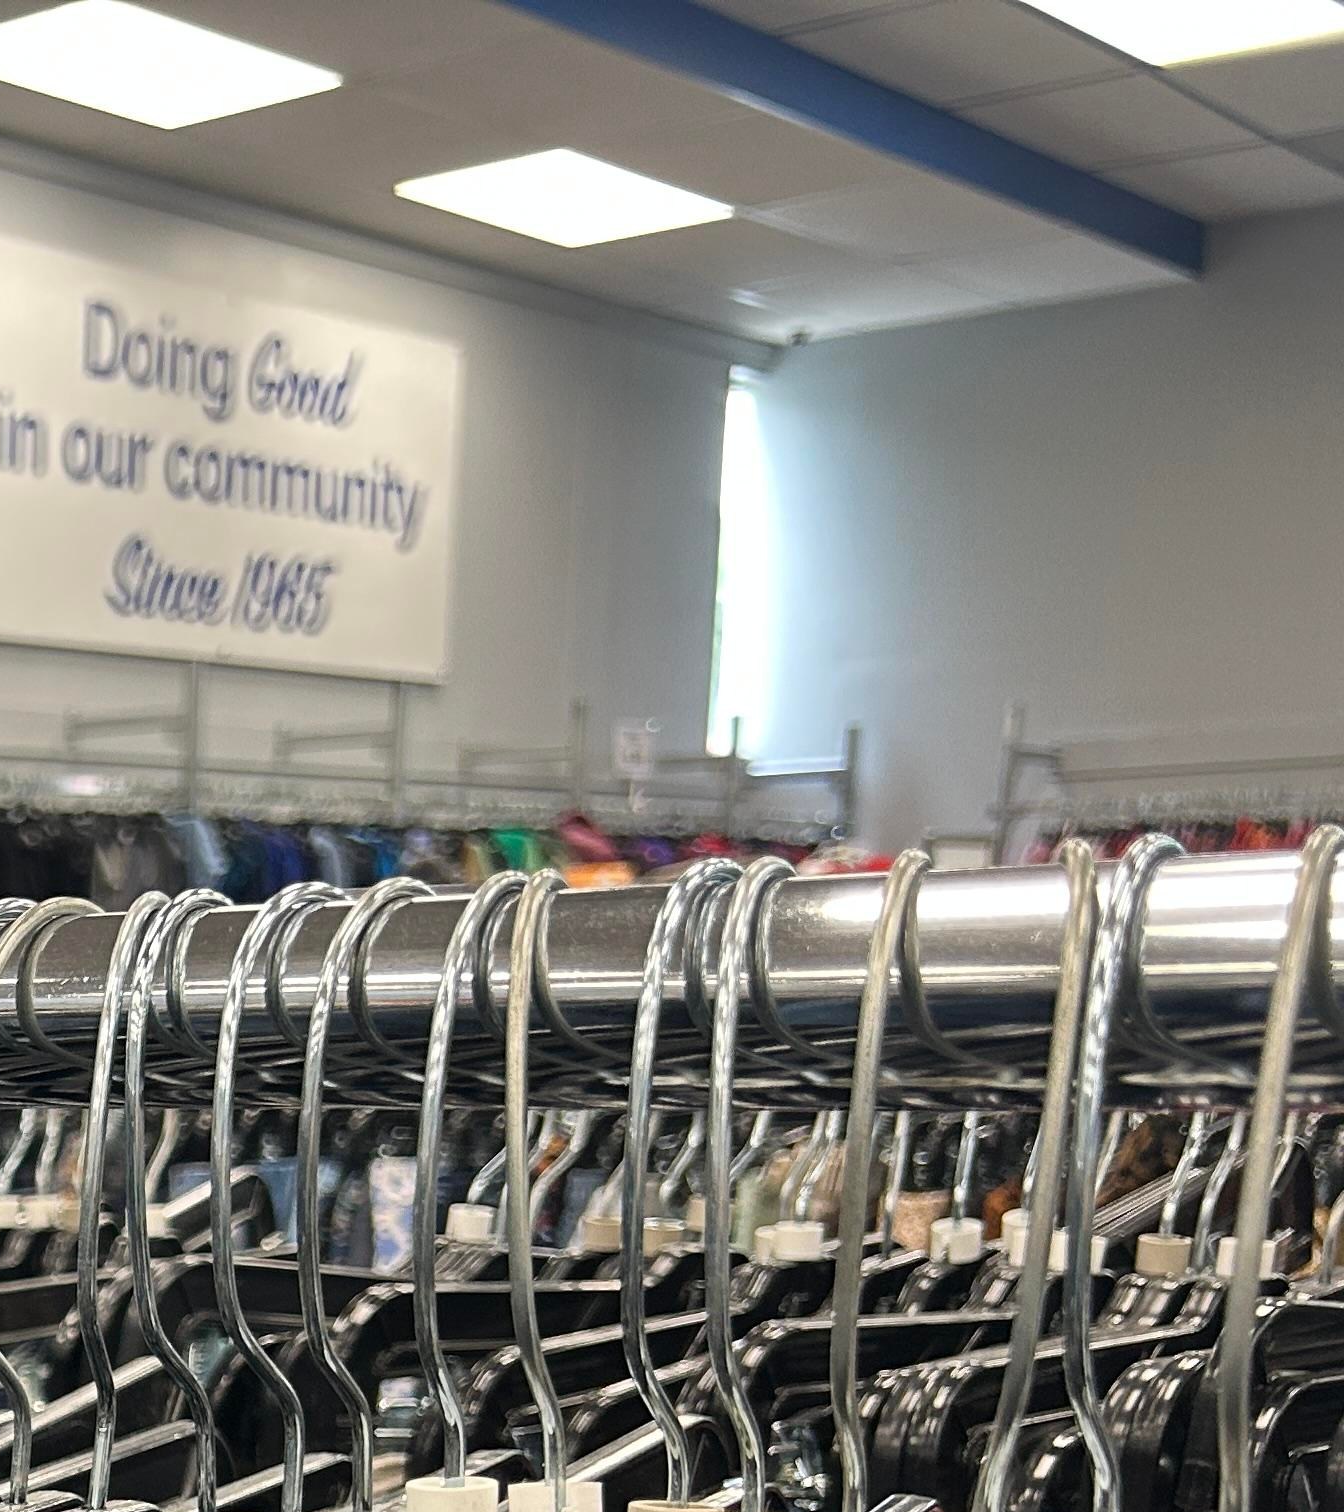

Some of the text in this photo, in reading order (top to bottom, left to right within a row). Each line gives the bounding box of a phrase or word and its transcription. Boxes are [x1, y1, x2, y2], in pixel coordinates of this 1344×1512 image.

[84, 301, 360, 428] Doing Good
[62, 418, 152, 492] our
[165, 437, 426, 552] community
[105, 534, 336, 636] Since 1965
